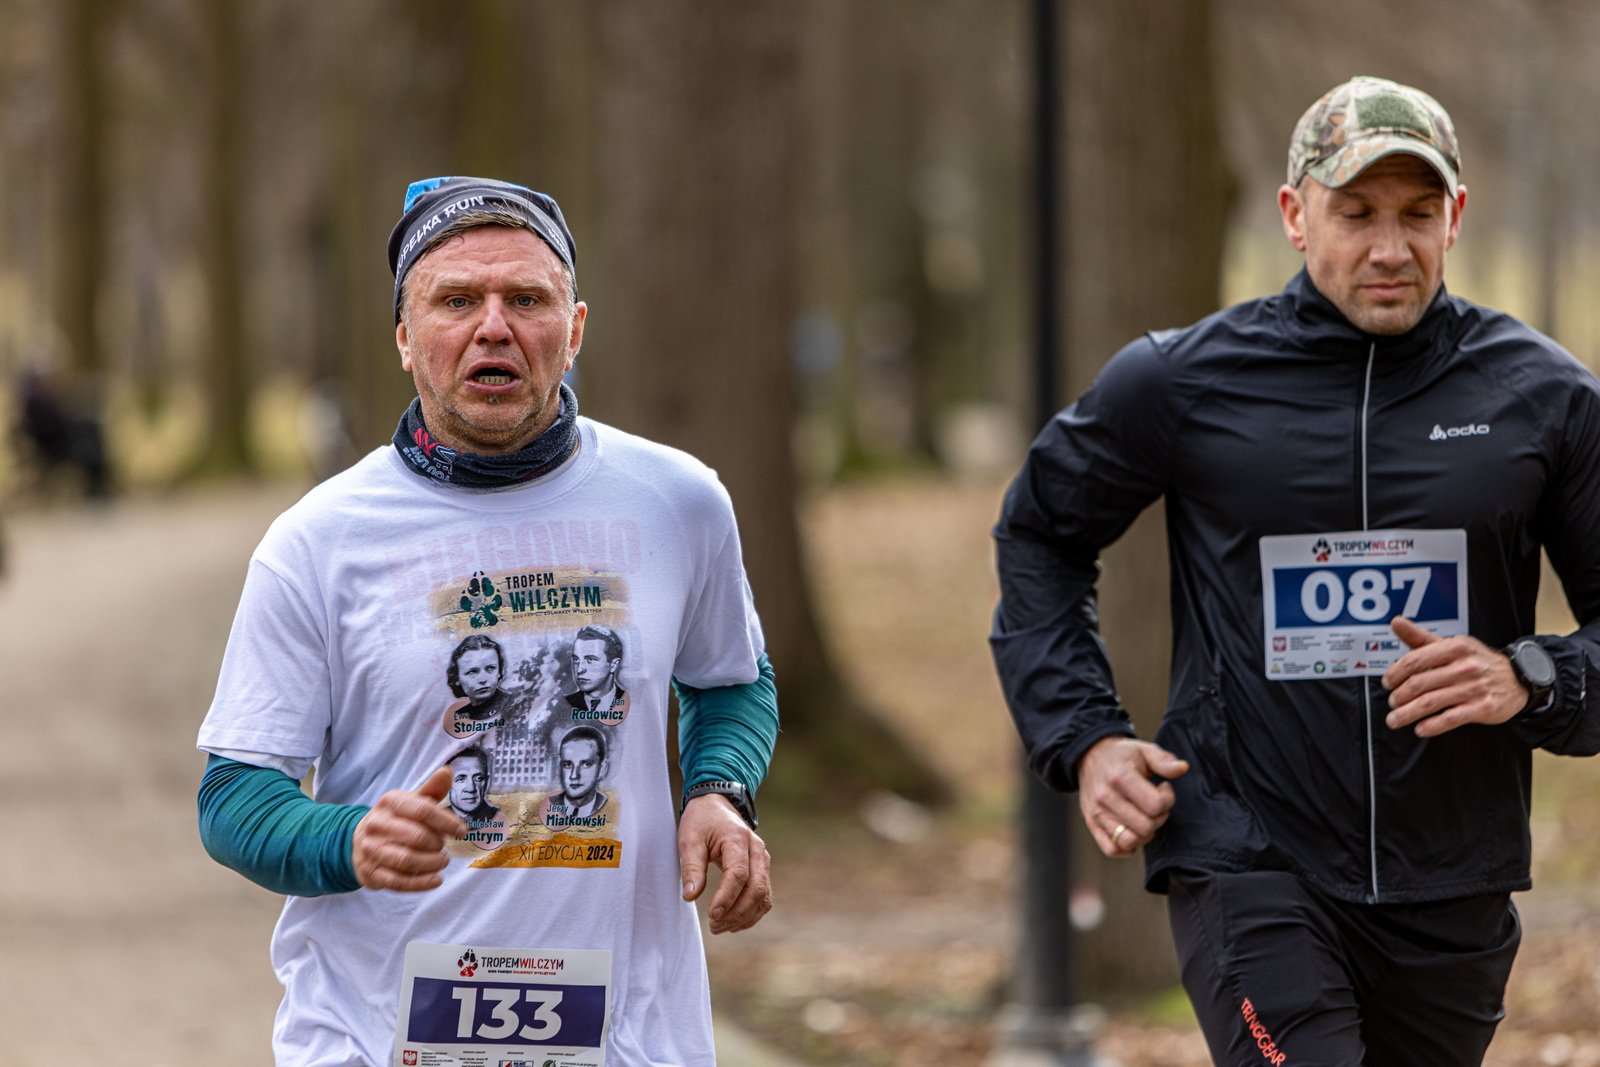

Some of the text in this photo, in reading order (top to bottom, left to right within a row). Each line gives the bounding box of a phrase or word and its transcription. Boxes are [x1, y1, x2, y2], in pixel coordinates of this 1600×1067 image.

[443, 195, 484, 218] RUN
[1333, 539, 1414, 552] TROPEMWILCZYM
[505, 572, 555, 589] TROPEM
[508, 586, 602, 613] WILCZYM
[1301, 566, 1432, 623] 087
[572, 708, 624, 720] Rodowicz
[546, 814, 607, 827] Miatkowski
[455, 830, 504, 845] ontrym
[518, 845, 615, 861] XII EDYCJA 2024
[481, 956, 564, 970] TROPEMWILCZYM
[451, 987, 564, 1041] 133
